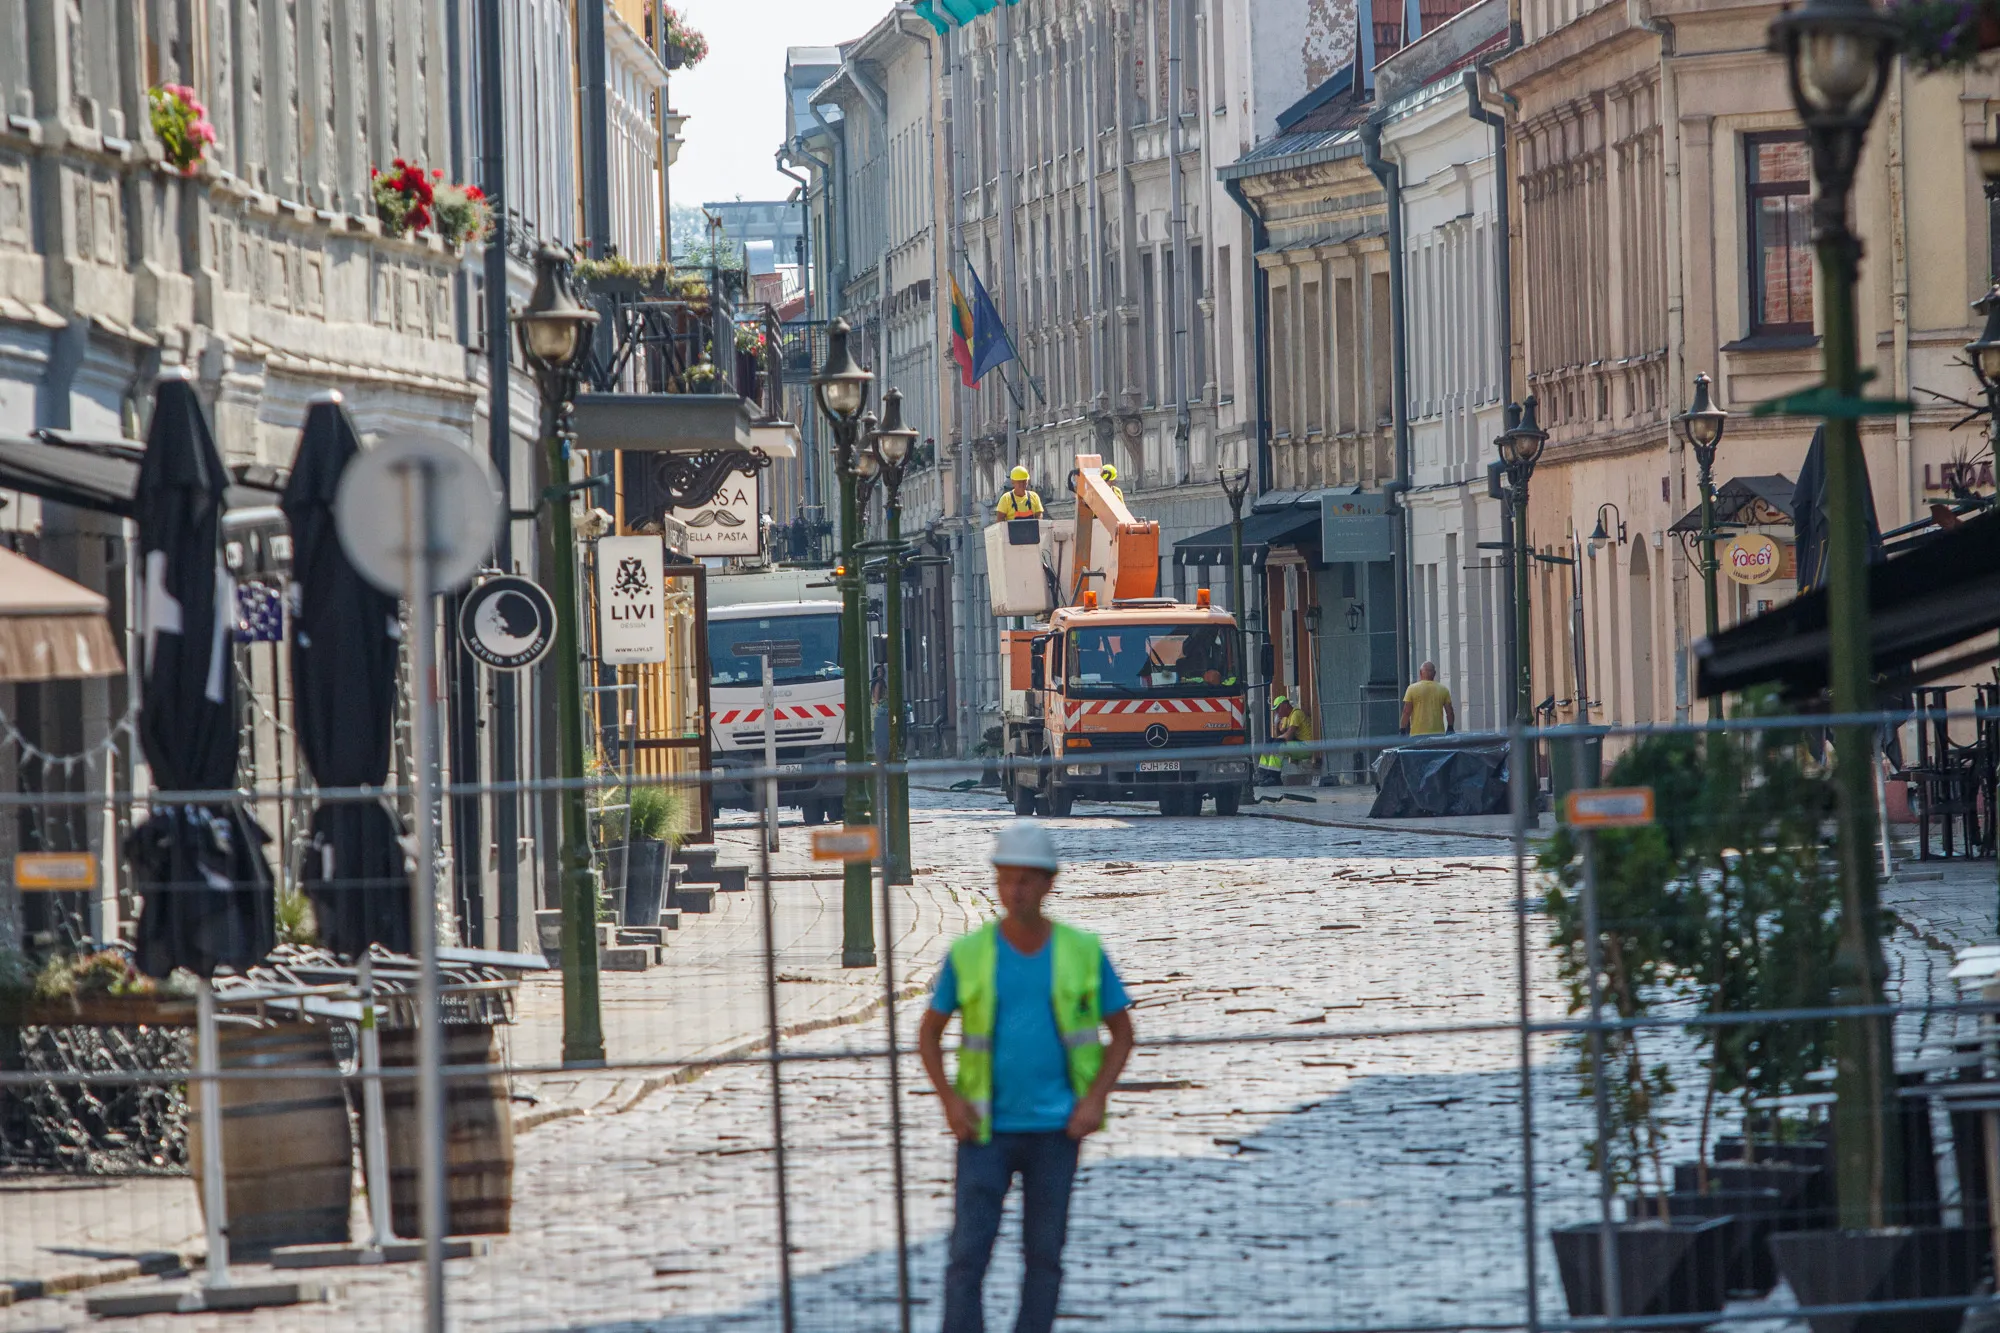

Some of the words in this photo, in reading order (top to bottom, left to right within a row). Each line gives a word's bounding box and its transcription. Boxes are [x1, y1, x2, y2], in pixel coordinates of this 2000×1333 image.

[717, 531, 749, 541] PASTA
[1732, 552, 1772, 566] YOGGY
[611, 604, 655, 620] LIVI
[732, 719, 826, 731] EURCARGO
[1140, 763, 1159, 771] GJH
[1163, 762, 1179, 770] 268
